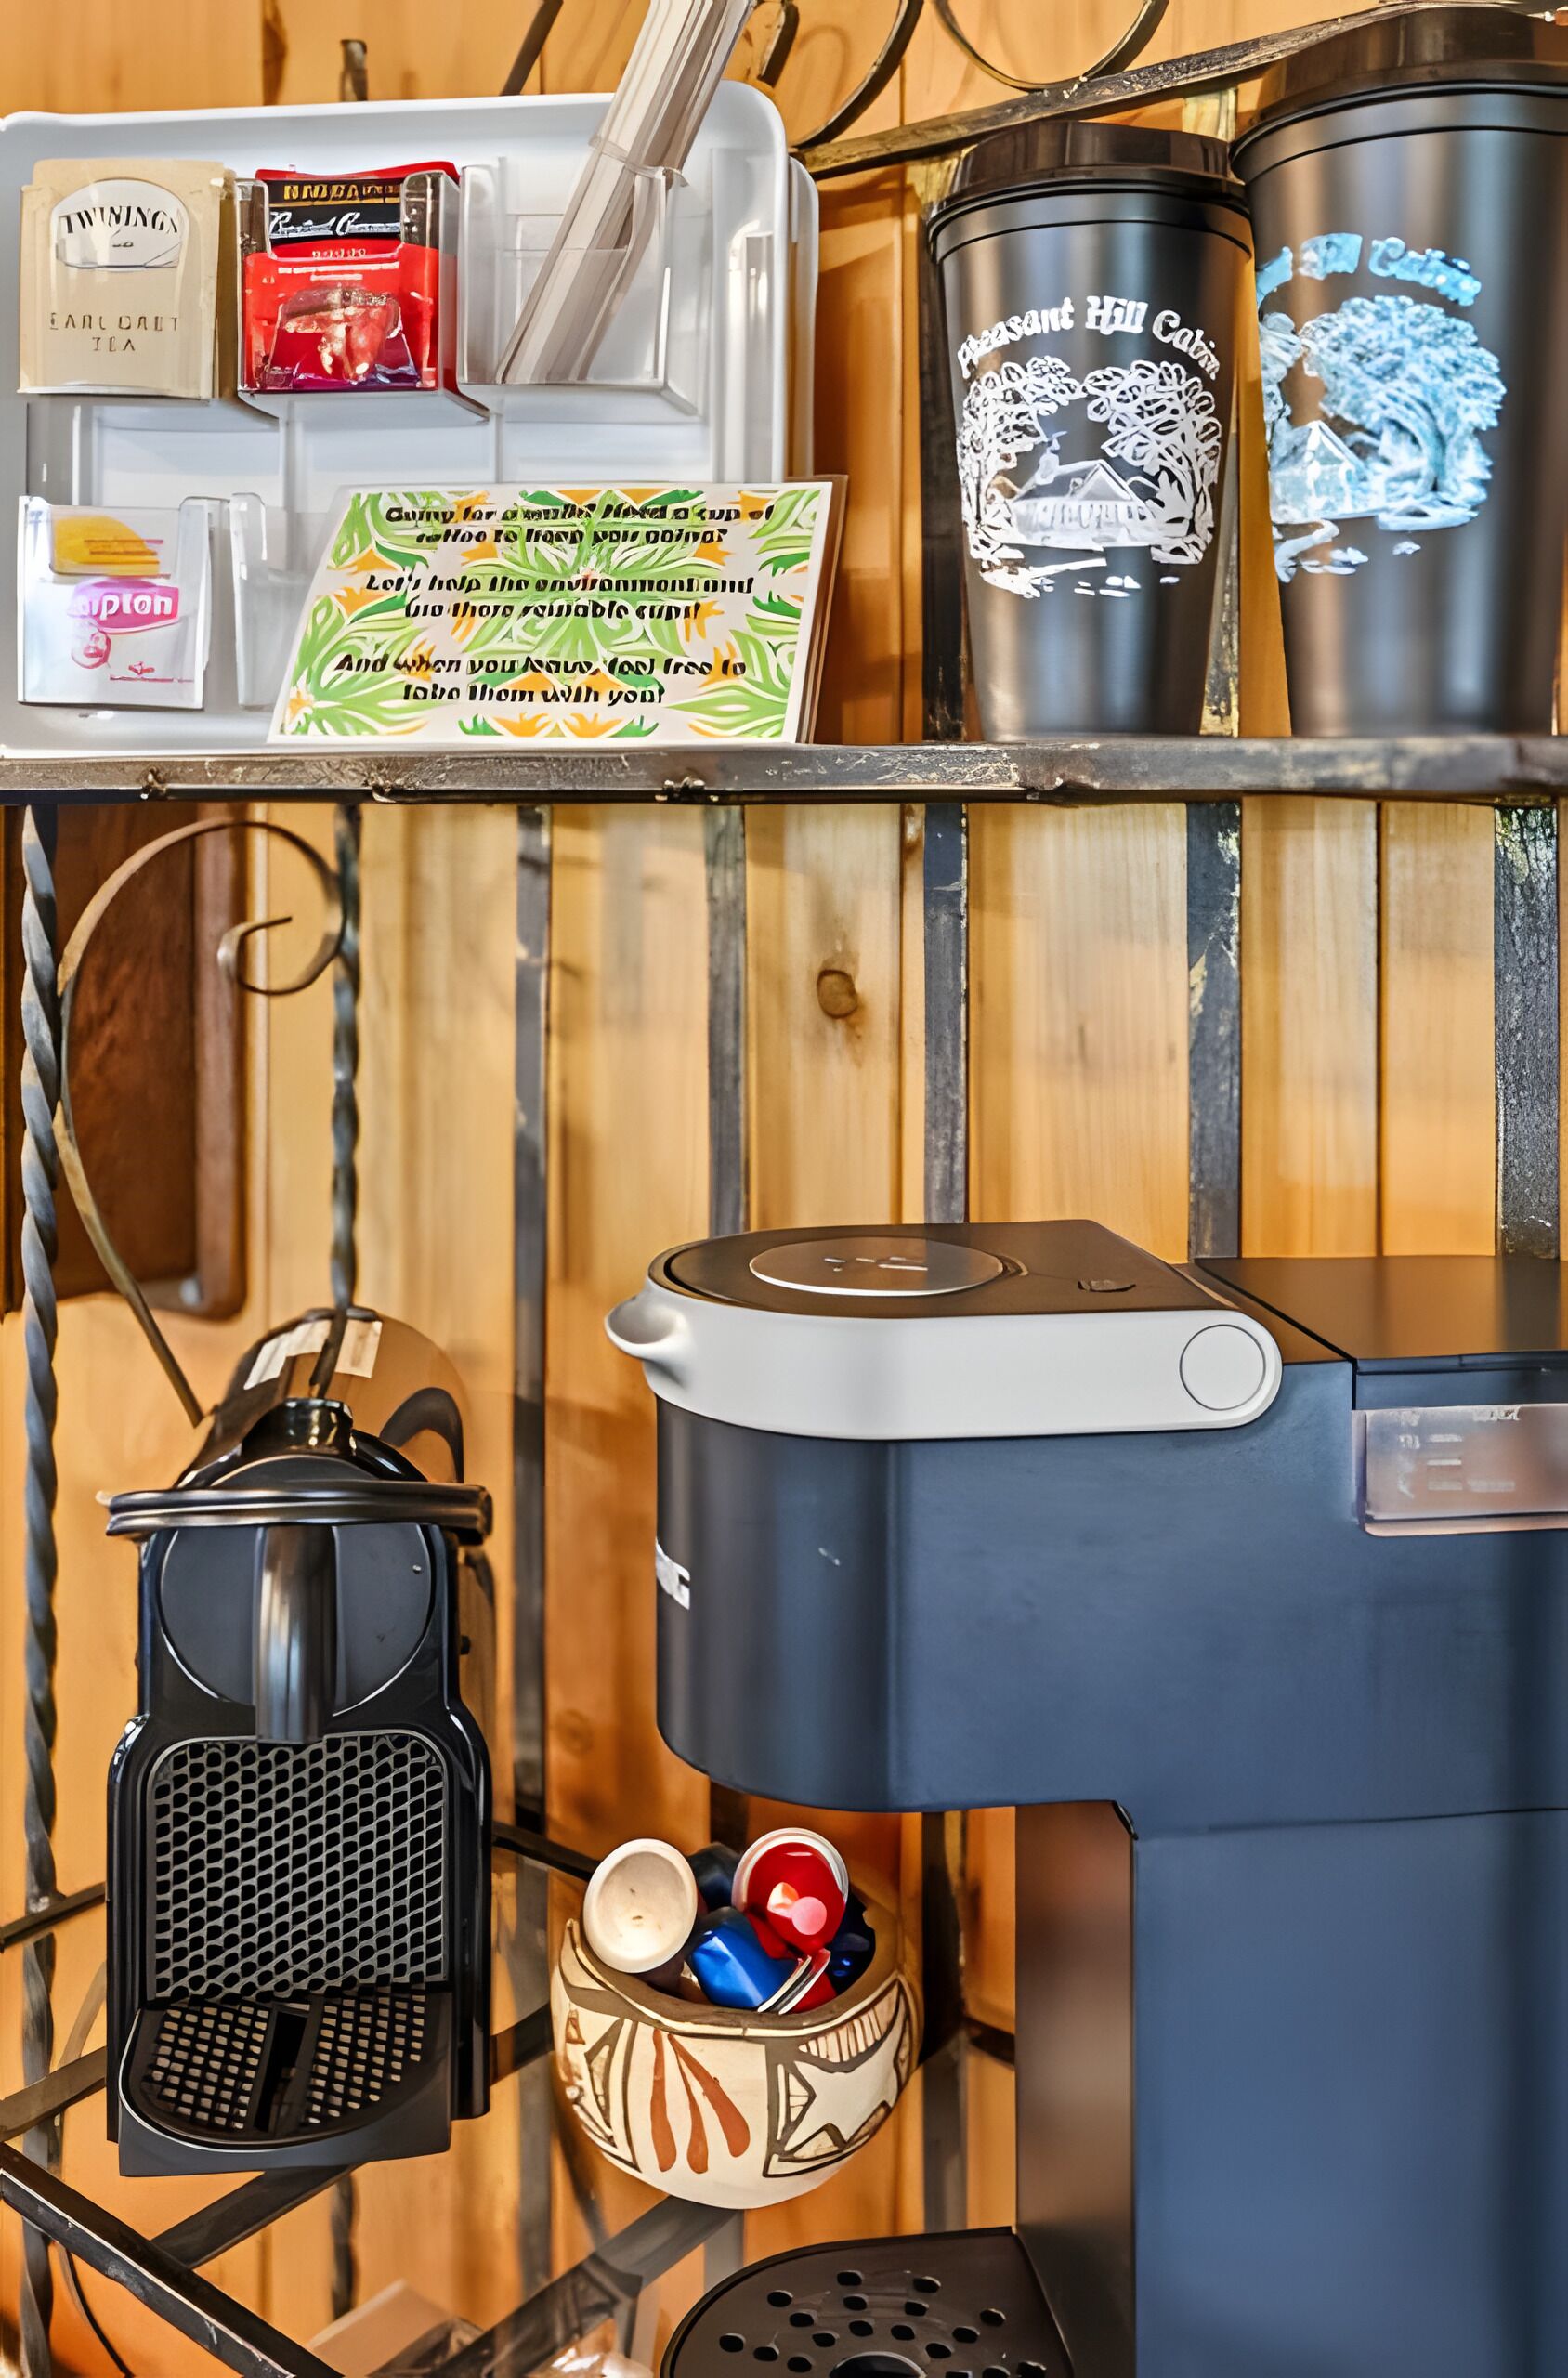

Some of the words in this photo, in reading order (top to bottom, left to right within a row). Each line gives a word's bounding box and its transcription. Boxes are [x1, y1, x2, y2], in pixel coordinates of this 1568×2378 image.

[59, 205, 178, 234] TWININGS
[1085, 295, 1149, 335] Hill
[334, 653, 389, 673] And
[467, 659, 517, 674] you
